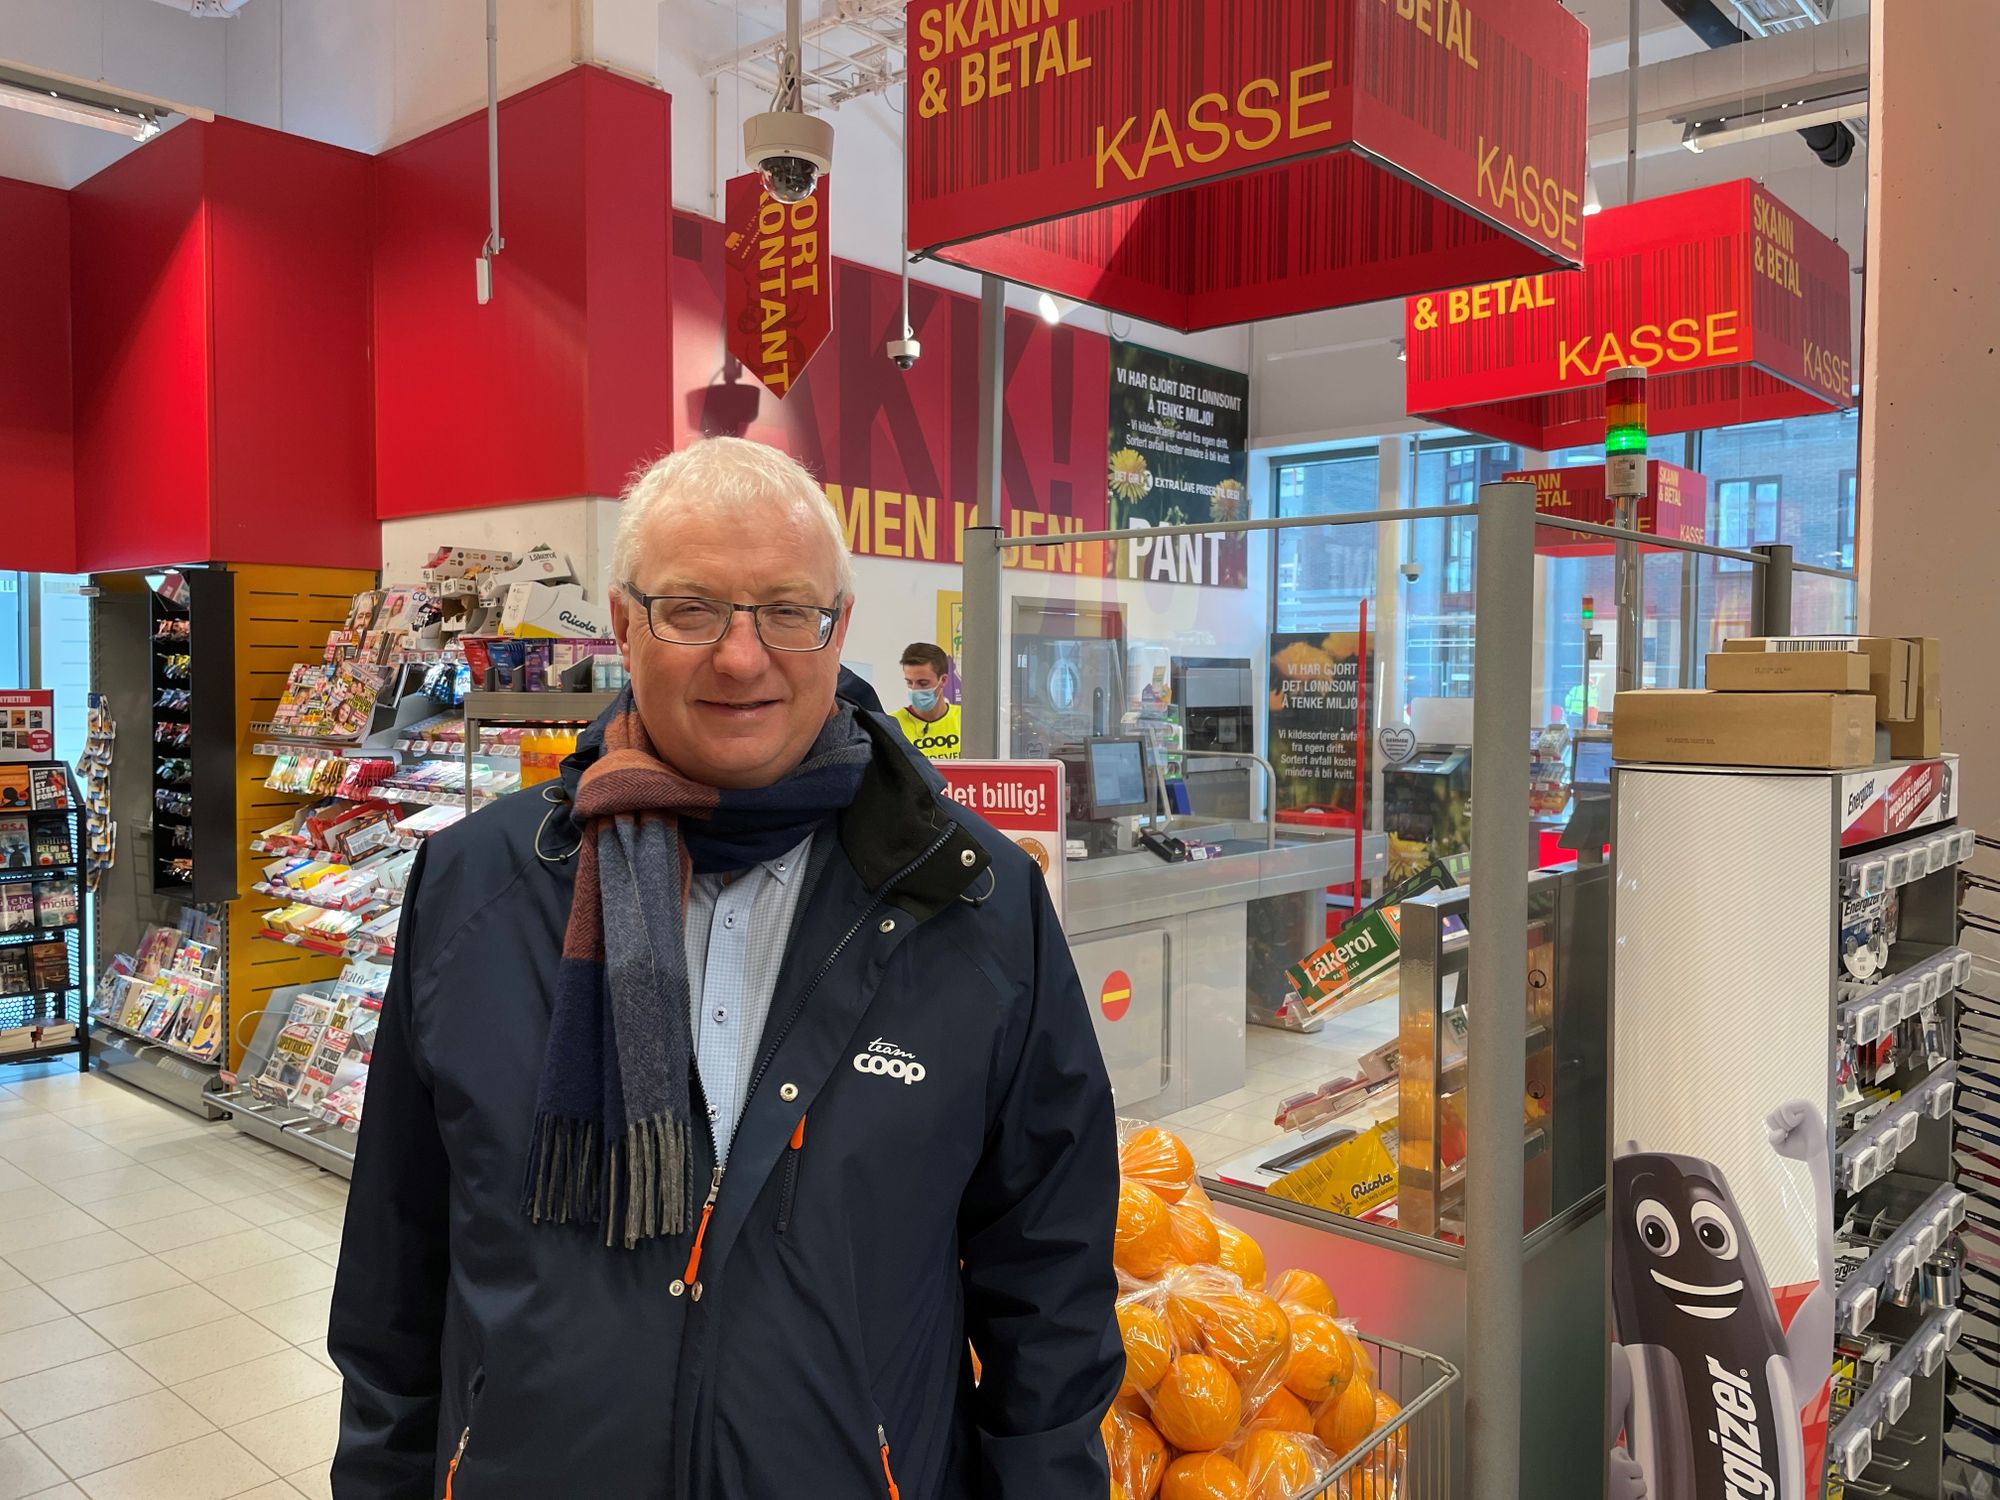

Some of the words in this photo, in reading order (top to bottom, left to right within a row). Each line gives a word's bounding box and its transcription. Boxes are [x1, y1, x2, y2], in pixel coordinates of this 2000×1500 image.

[918, 67, 948, 119] &
[960, 18, 1092, 107] BETAL
[1095, 61, 1334, 190] KASSE
[1476, 135, 1579, 251] KASSE
[1753, 192, 1795, 254] SKANN
[790, 194, 819, 296] ORT
[1754, 237, 1764, 273] &
[1766, 242, 1803, 298] BETAL
[1413, 297, 1438, 331] &
[1448, 274, 1555, 325] BETAL
[1558, 310, 1739, 381] KASSE
[1802, 337, 1850, 399] KASSE
[1116, 367, 1127, 384] VI
[1128, 369, 1148, 389] HAR
[1149, 376, 1179, 397] GJORT
[1179, 383, 1196, 401] DET
[1147, 393, 1155, 414] Å
[1156, 400, 1184, 420] TENKE
[1130, 419, 1137, 431] Vi
[1125, 434, 1147, 448] Sortert
[1165, 442, 1184, 455] koster
[1184, 446, 1204, 459] mindre
[1154, 477, 1180, 490] EXTRA
[1180, 481, 1195, 494] LAVE
[1196, 484, 1216, 497] PRISER
[1658, 466, 1680, 488] SKANN
[1536, 489, 1572, 508] ETAL
[1664, 489, 1682, 507] BETAL
[824, 483, 937, 561] MEN
[954, 501, 1083, 574] IJEN!
[1128, 516, 1226, 586] PANT
[559, 610, 598, 634] Ricola
[1287, 664, 1297, 675] VI
[1300, 663, 1321, 675] HAR
[1323, 663, 1358, 676] GJORT
[1282, 680, 1302, 692] DET
[1304, 680, 1359, 693] LØNNSOM
[1281, 695, 1289, 708] Å
[1290, 697, 1323, 709] TENKE
[913, 734, 960, 749] coop
[1278, 729, 1287, 739] Vi
[1288, 729, 1339, 742] kildesorterer
[1340, 730, 1358, 742] avfa
[1291, 742, 1303, 752] fra
[1304, 743, 1325, 755] egen
[1326, 742, 1346, 754] drift.
[1280, 754, 1308, 765] Sortert
[1310, 754, 1332, 766] avfall
[1333, 755, 1357, 767] koste
[1284, 767, 1313, 778] mindre
[1321, 767, 1333, 778] bli
[1334, 768, 1355, 780] kvitt.
[982, 781, 1046, 815] billig!
[1847, 777, 1875, 817] Energizer
[1303, 927, 1378, 988] Läkerol
[1332, 960, 1361, 981] PASTILLES
[867, 1036, 916, 1059] team
[853, 1052, 926, 1085] coop
[1351, 1172, 1394, 1200] Ricola
[1704, 1353, 1776, 1500] rgizer
